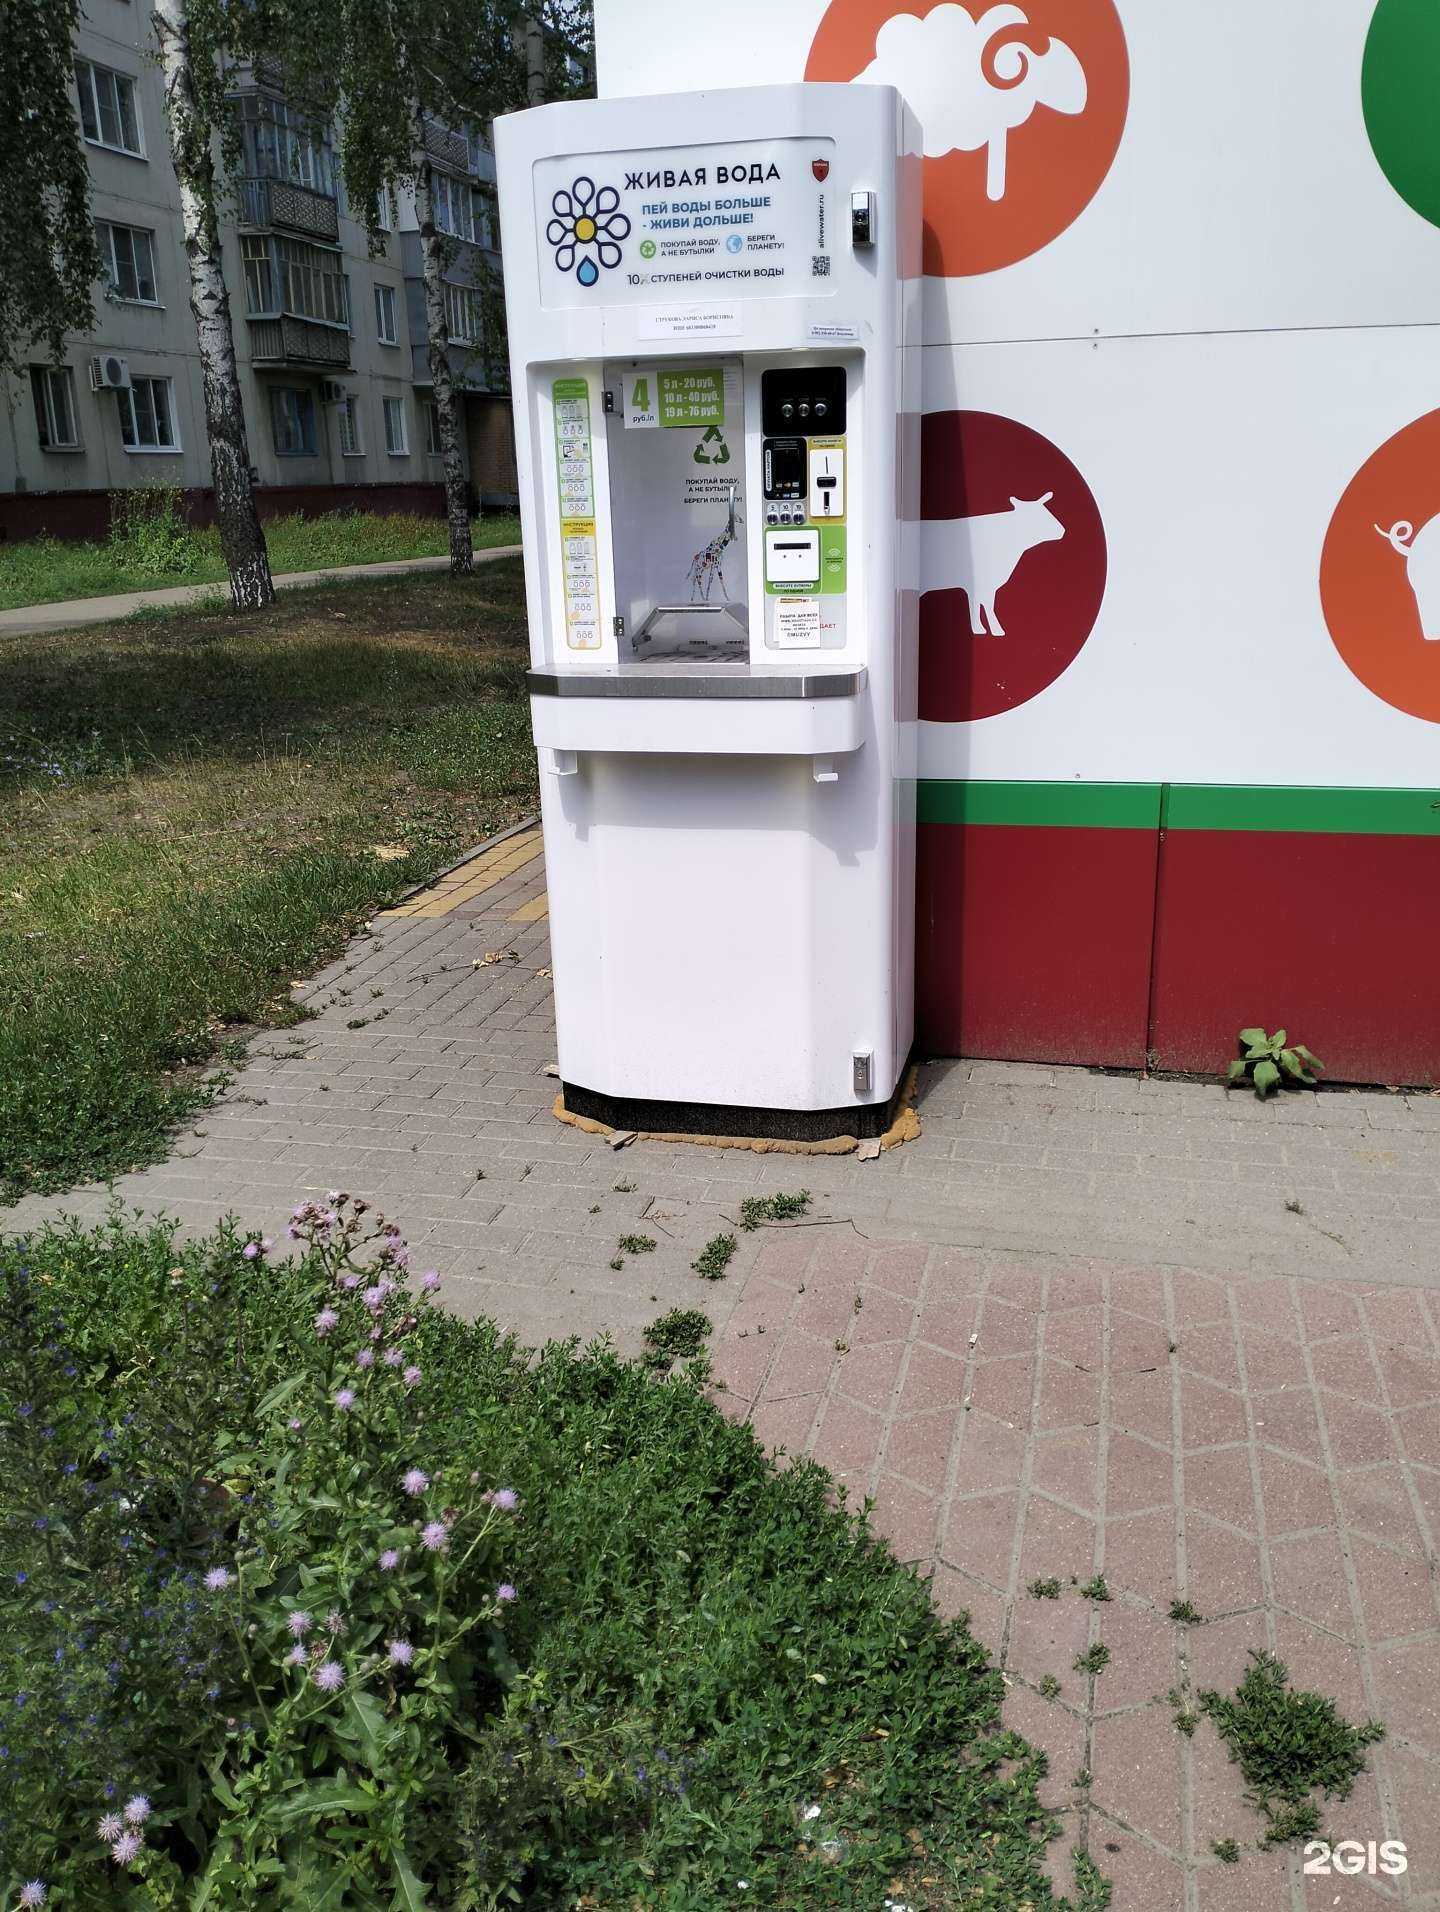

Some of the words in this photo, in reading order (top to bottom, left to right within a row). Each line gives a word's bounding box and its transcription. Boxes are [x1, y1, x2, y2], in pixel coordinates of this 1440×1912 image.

[624, 168, 706, 190] ЖИВАЯ
[716, 162, 781, 184] ВОДА
[642, 201, 668, 215] ПЕЙ
[672, 201, 711, 213] ВОДЫ
[715, 196, 771, 210] БОЛЬШЕ
[650, 218, 690, 230] ЖИВИ
[693, 213, 754, 228] ДОЛЬШЕ!
[660, 239, 697, 249] ПОКУПАЙ
[747, 234, 776, 242] БЕРЕГИ
[679, 248, 715, 256] БУТЫЛКИ
[650, 271, 702, 283] СТУПЕНЕЙ
[704, 269, 751, 280] ОЧИСТКИ
[753, 267, 784, 277] ВОДЫ
[663, 379, 670, 390] 5
[671, 380, 678, 389] л
[684, 377, 695, 389] 20
[631, 378, 651, 412] 4
[664, 392, 675, 404] 10
[688, 391, 700, 402] 40
[664, 406, 676, 418] 19
[689, 405, 700, 417] 76
